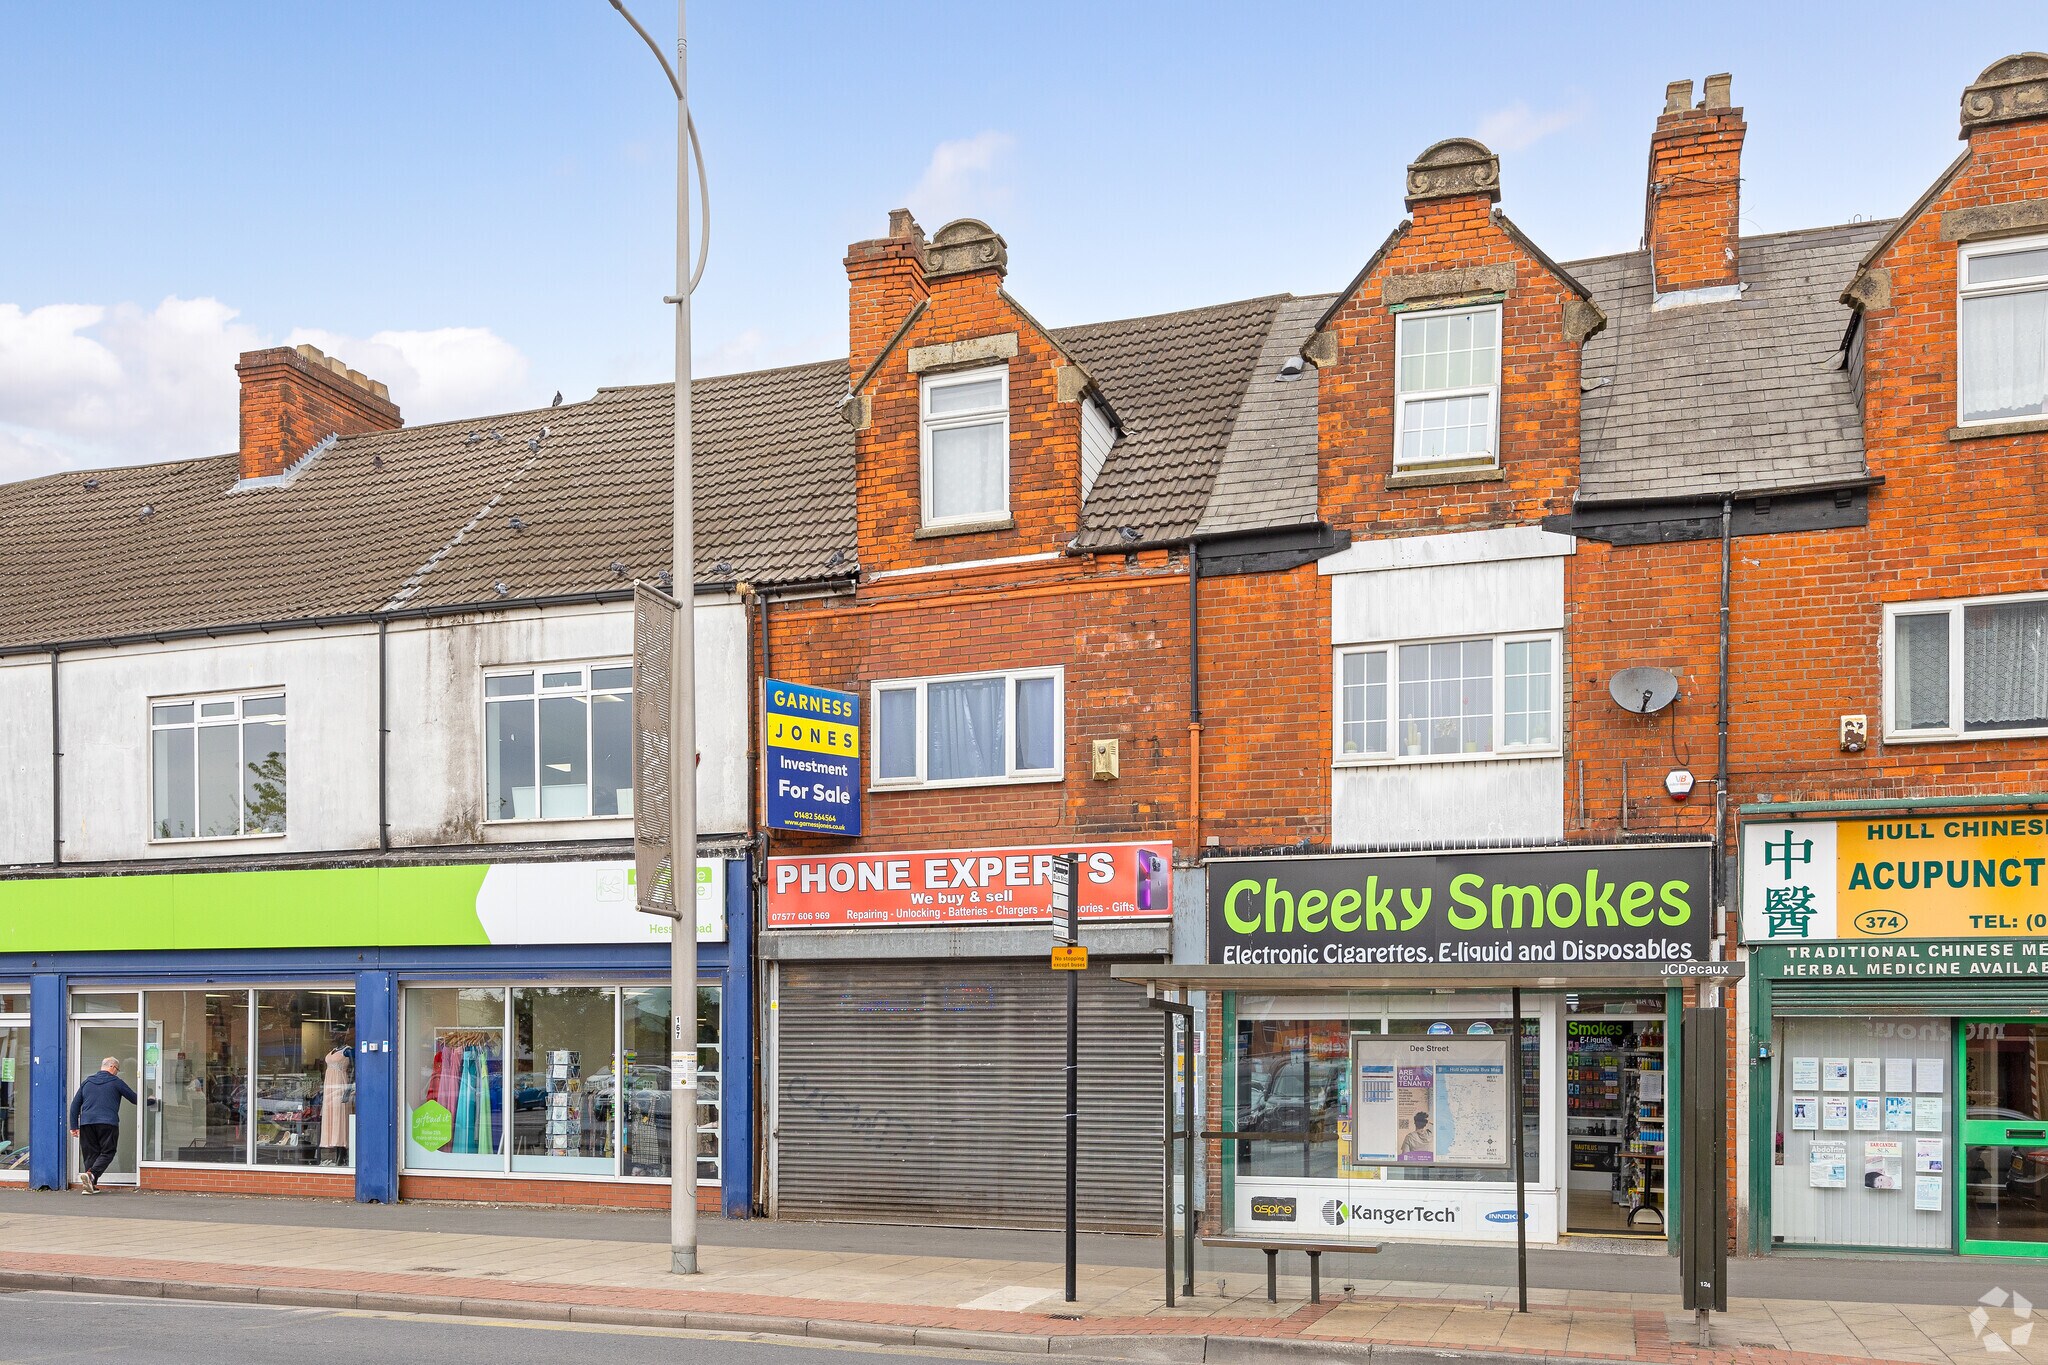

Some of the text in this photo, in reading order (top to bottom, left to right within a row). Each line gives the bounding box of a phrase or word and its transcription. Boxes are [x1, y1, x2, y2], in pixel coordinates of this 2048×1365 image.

[774, 690, 852, 718] GARNESS
[775, 723, 853, 748] JONES
[780, 755, 848, 776] Investment
[778, 779, 851, 804] For Sale
[793, 811, 836, 822] 01482 564564
[784, 819, 846, 831] www.garnessjones.co.uk
[1867, 818, 2048, 840] HULL CHINES
[775, 860, 912, 895] PHONE
[1848, 857, 2046, 891] ACUPUNCT
[911, 889, 1013, 906] We buy & sell
[1223, 869, 1692, 934] Cheeky Smokes
[771, 913, 796, 921] 07577
[798, 912, 813, 920] 606
[846, 901, 1135, 921] Repairing Unlocking Batteries Chargers Asories Gifts
[649, 923, 712, 934] Hess oad
[1865, 916, 1899, 929] 374
[1969, 914, 2018, 929] TEL:
[1223, 938, 1692, 964] Electronic Cigarettes, E-liquid and Disposables
[1787, 943, 2048, 958] TRADITIONAL CHINESE ME
[1063, 955, 1085, 963] stopping
[1660, 963, 1729, 975] JCDecaux
[1783, 964, 1859, 976] HERBAL
[1866, 963, 1961, 976] MEDICINE
[1568, 1021, 1623, 1036] Smokes
[1409, 1044, 1450, 1052] Dee Street
[1574, 1143, 1598, 1151] NAUTILUS
[1253, 1204, 1292, 1216] aspire
[1351, 1204, 1455, 1224] KangerTech
